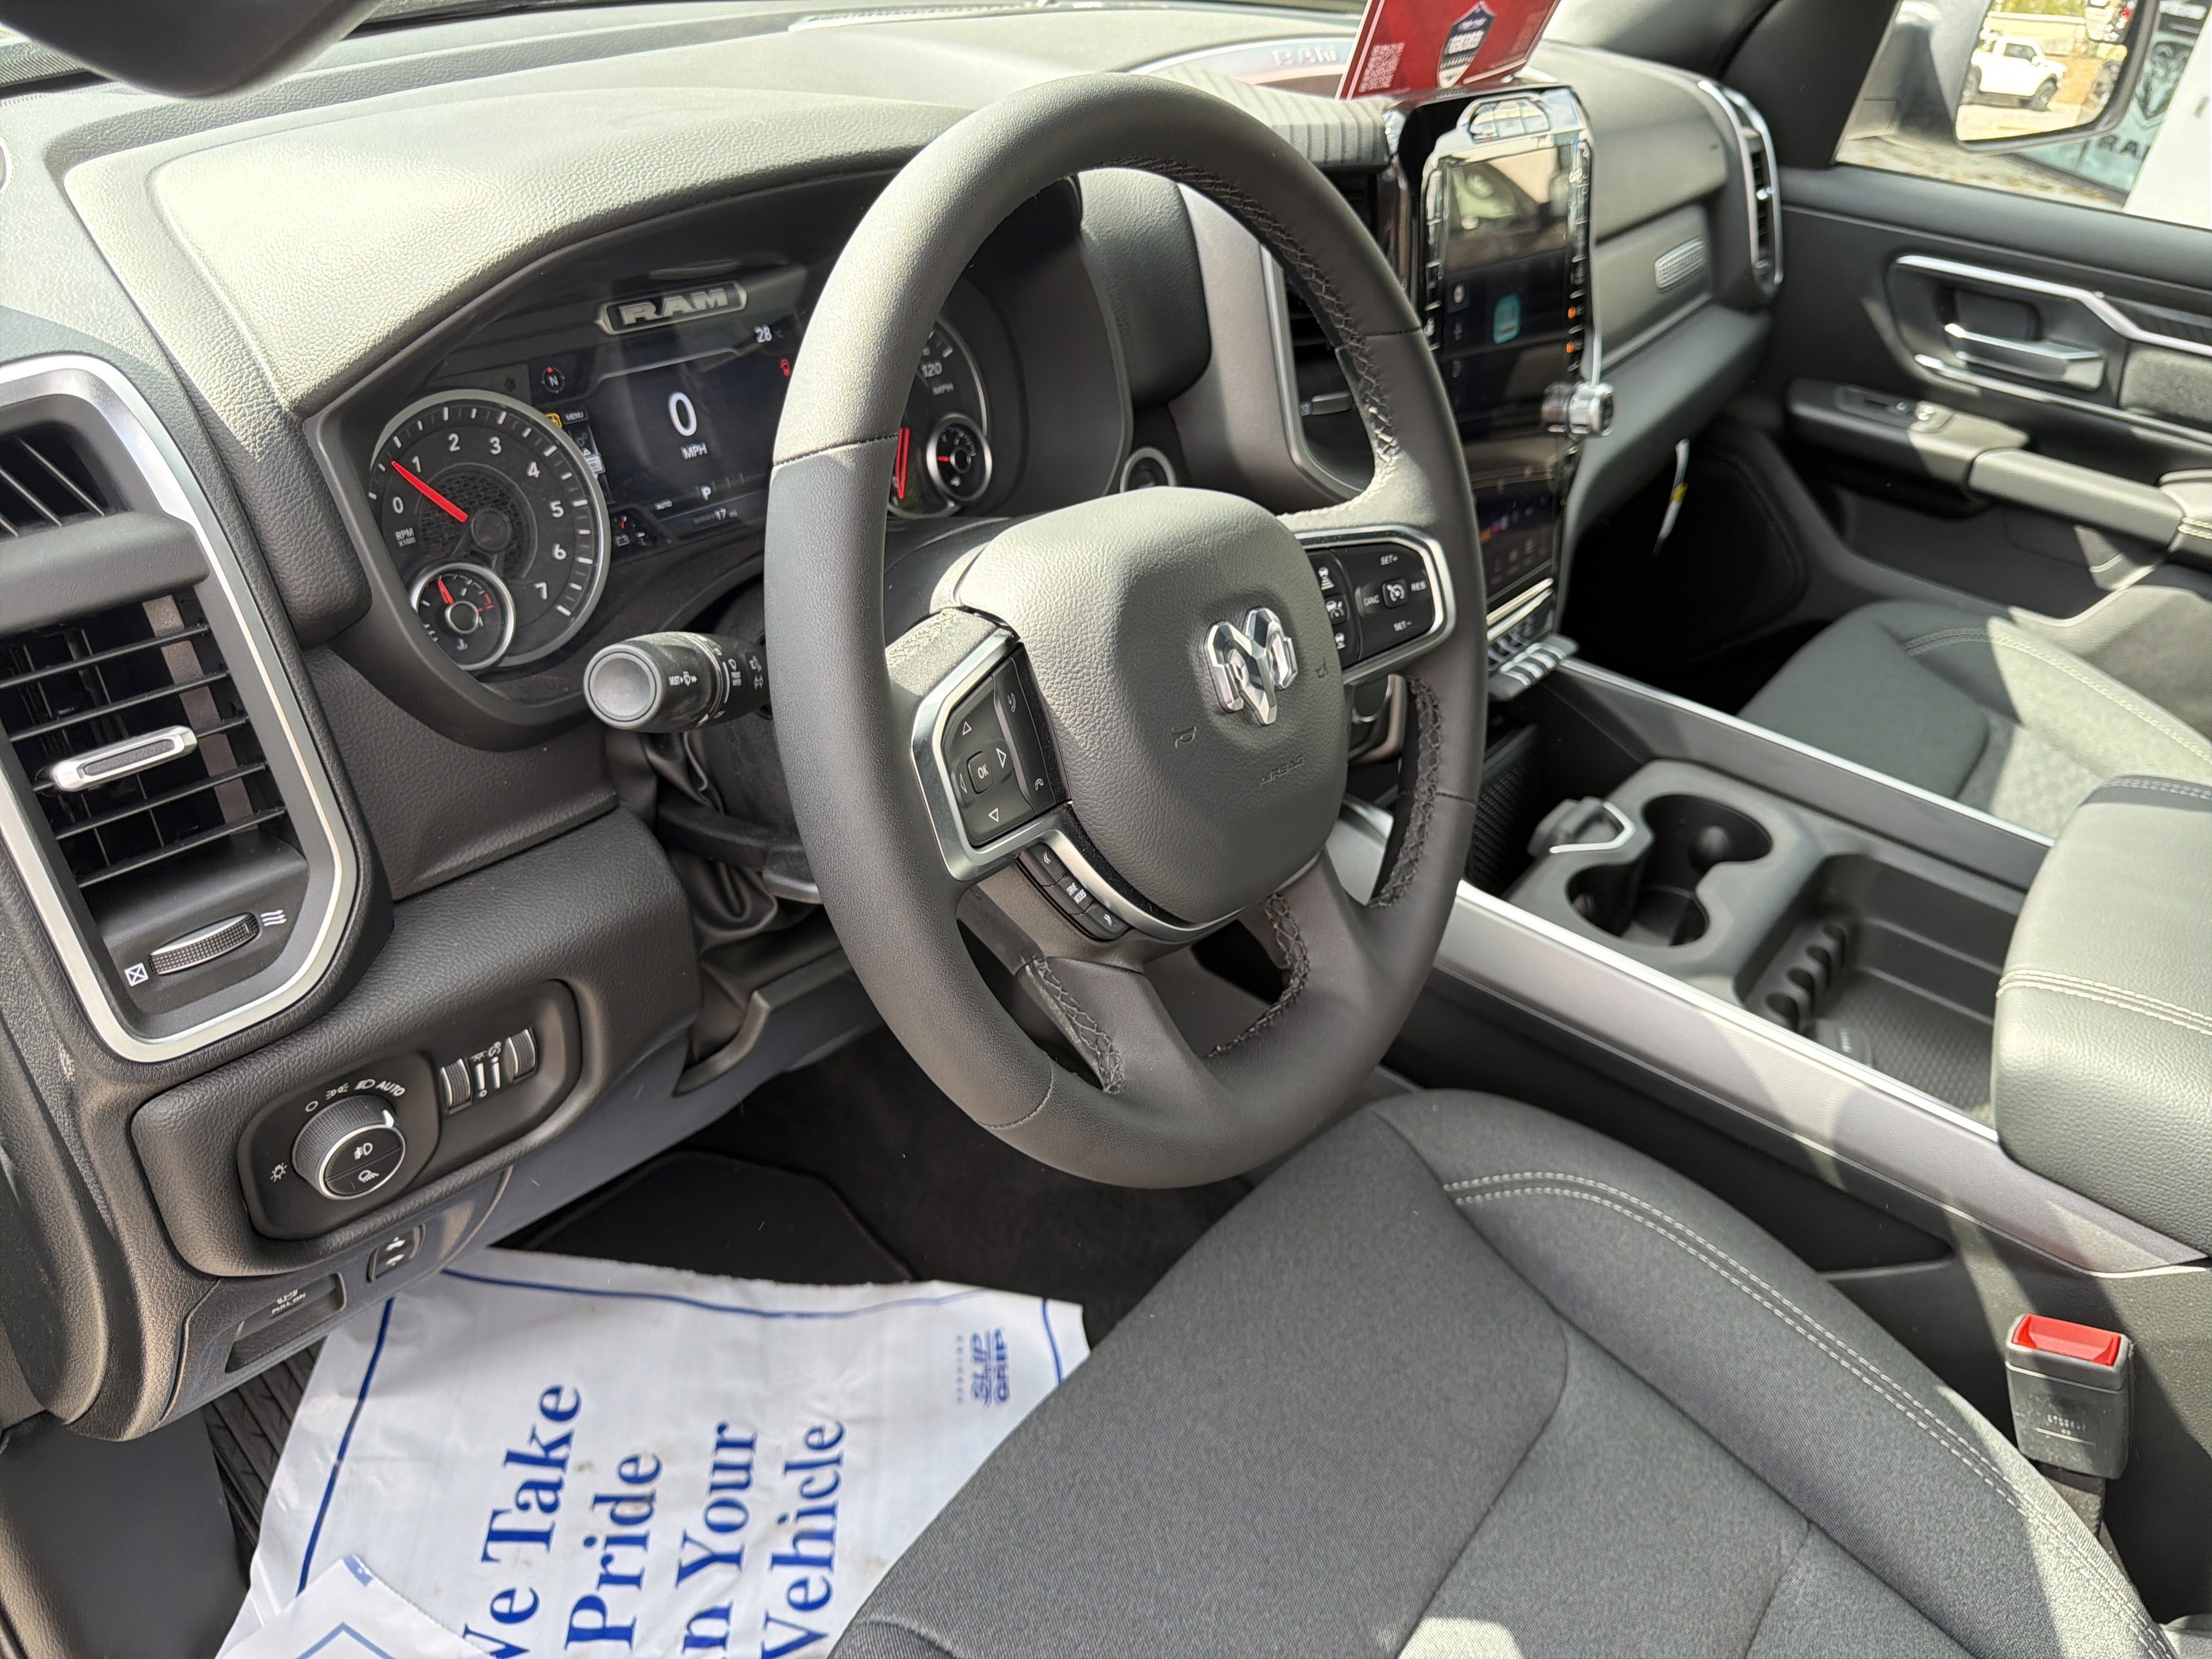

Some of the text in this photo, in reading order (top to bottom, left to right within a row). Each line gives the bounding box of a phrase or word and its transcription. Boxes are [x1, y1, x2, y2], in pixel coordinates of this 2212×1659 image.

[619, 288, 728, 325] RAM
[754, 325, 772, 343] 28
[921, 360, 942, 377] 120
[549, 375, 558, 386] N
[668, 391, 697, 437] 0
[448, 433, 460, 452] 2
[489, 437, 502, 454] 3
[680, 442, 708, 459] MPH
[413, 456, 421, 473] 1
[527, 461, 540, 478] 4
[700, 486, 712, 500] P
[392, 496, 404, 514] 0
[549, 500, 564, 517] 5
[715, 508, 726, 521] 17
[396, 527, 414, 540] RPM
[552, 543, 567, 560] 6
[534, 582, 548, 600] 7
[1410, 580, 1426, 592] RES
[978, 764, 989, 779] OK
[375, 1080, 405, 1097] AUTO
[481, 1384, 582, 1564] Take
[675, 1420, 758, 1659] n Your
[761, 1420, 845, 1659] Vehicle
[565, 1453, 663, 1651] Pride
